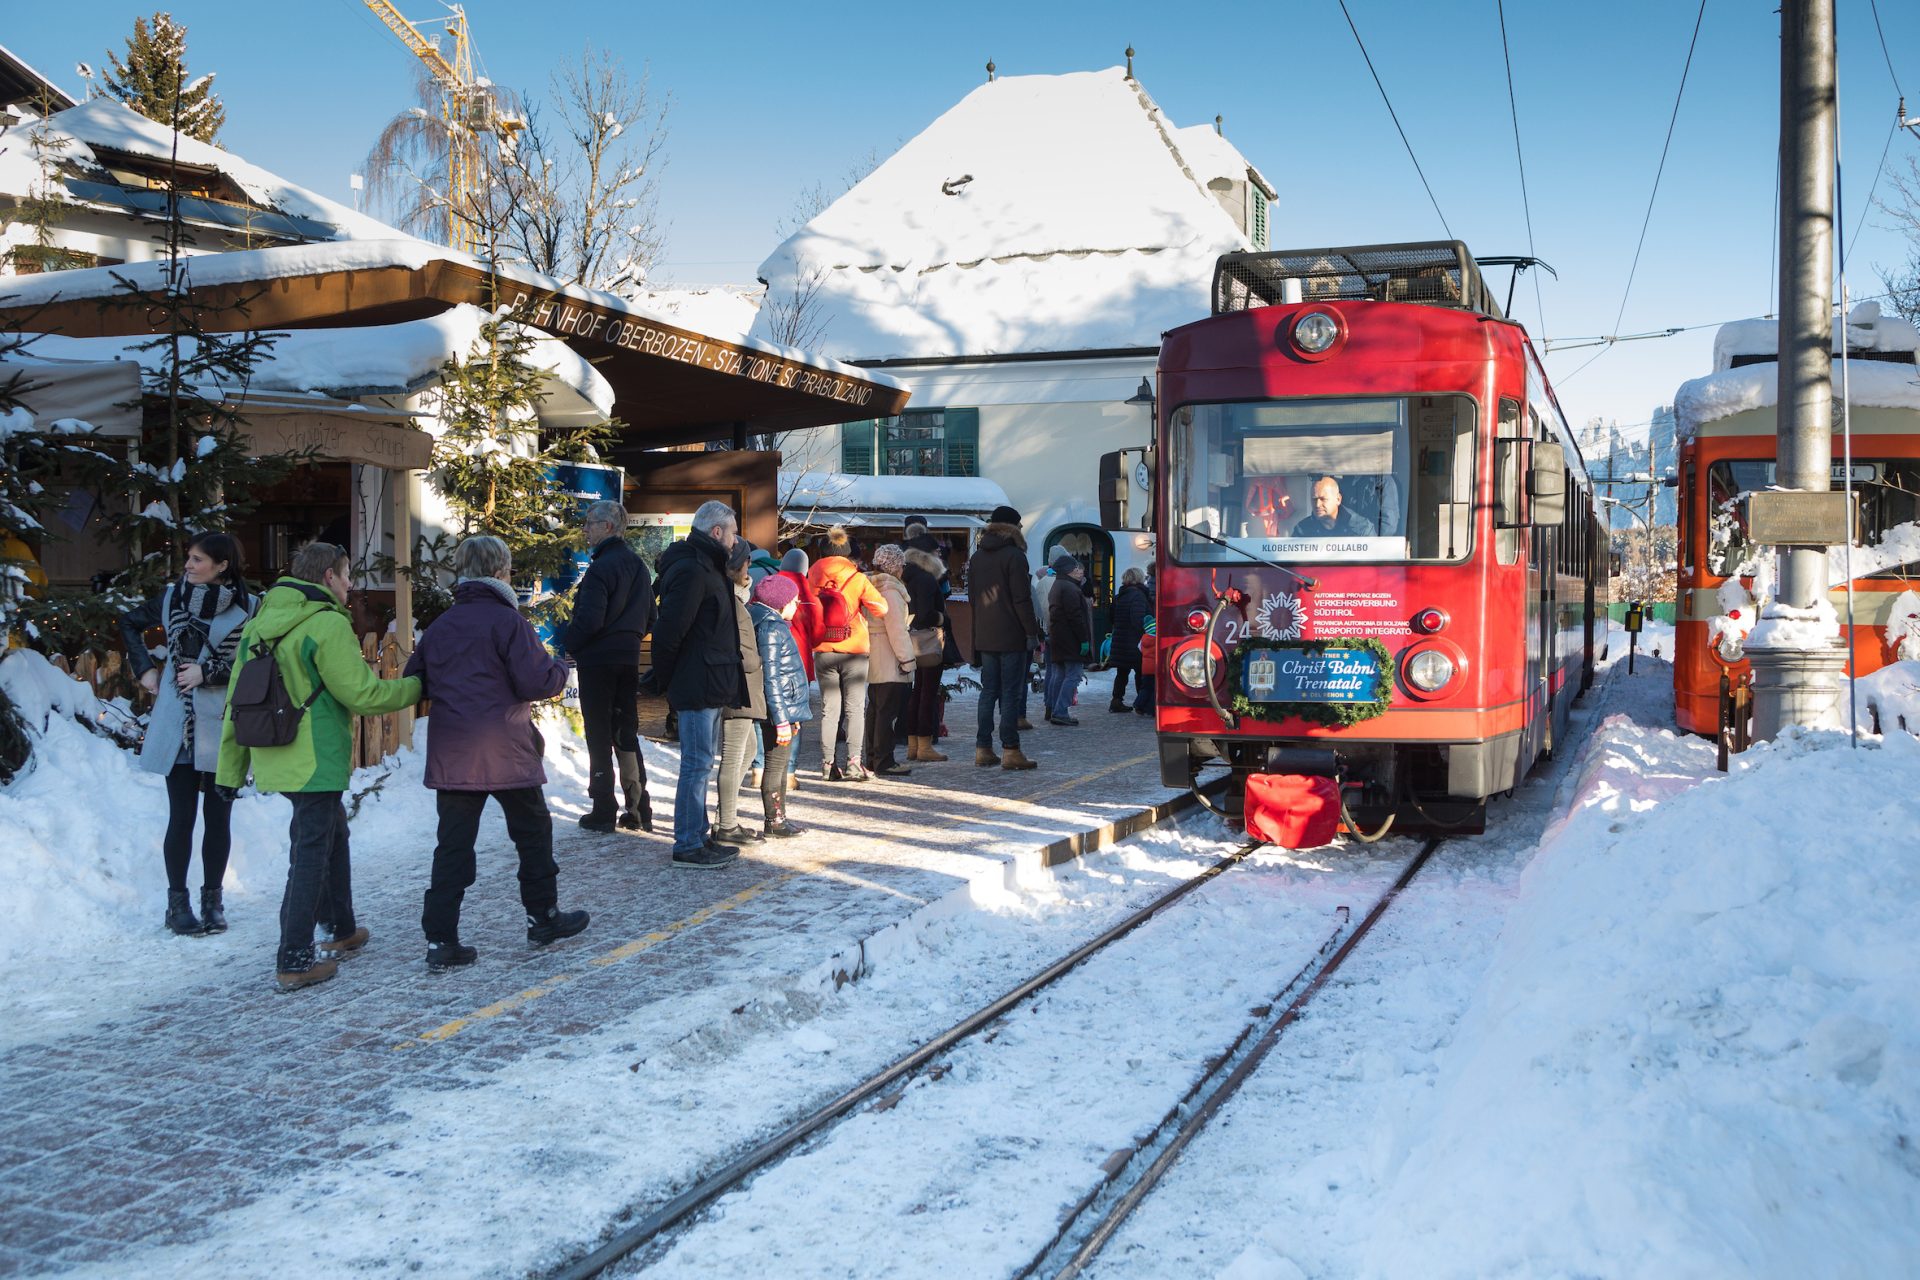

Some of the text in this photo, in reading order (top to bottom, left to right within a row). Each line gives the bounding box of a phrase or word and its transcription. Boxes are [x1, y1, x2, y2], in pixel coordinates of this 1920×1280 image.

[511, 292, 607, 338] BHNHOF
[605, 319, 707, 365] OBERBOZEN
[713, 349, 783, 384] STAZIONE
[780, 367, 873, 406] SOPRABOLZANO
[1830, 467, 1856, 478] LEN
[1262, 543, 1319, 552] KLOBENSTEIN
[1326, 543, 1369, 552] COLLALBO
[1313, 607, 1355, 616] SÜDTIROL
[1225, 620, 1252, 644] 24
[1313, 627, 1413, 635] TRASPORTO INTEGRATO
[1282, 660, 1376, 675] Christ Bahnl
[1294, 675, 1363, 690] Trenatale
